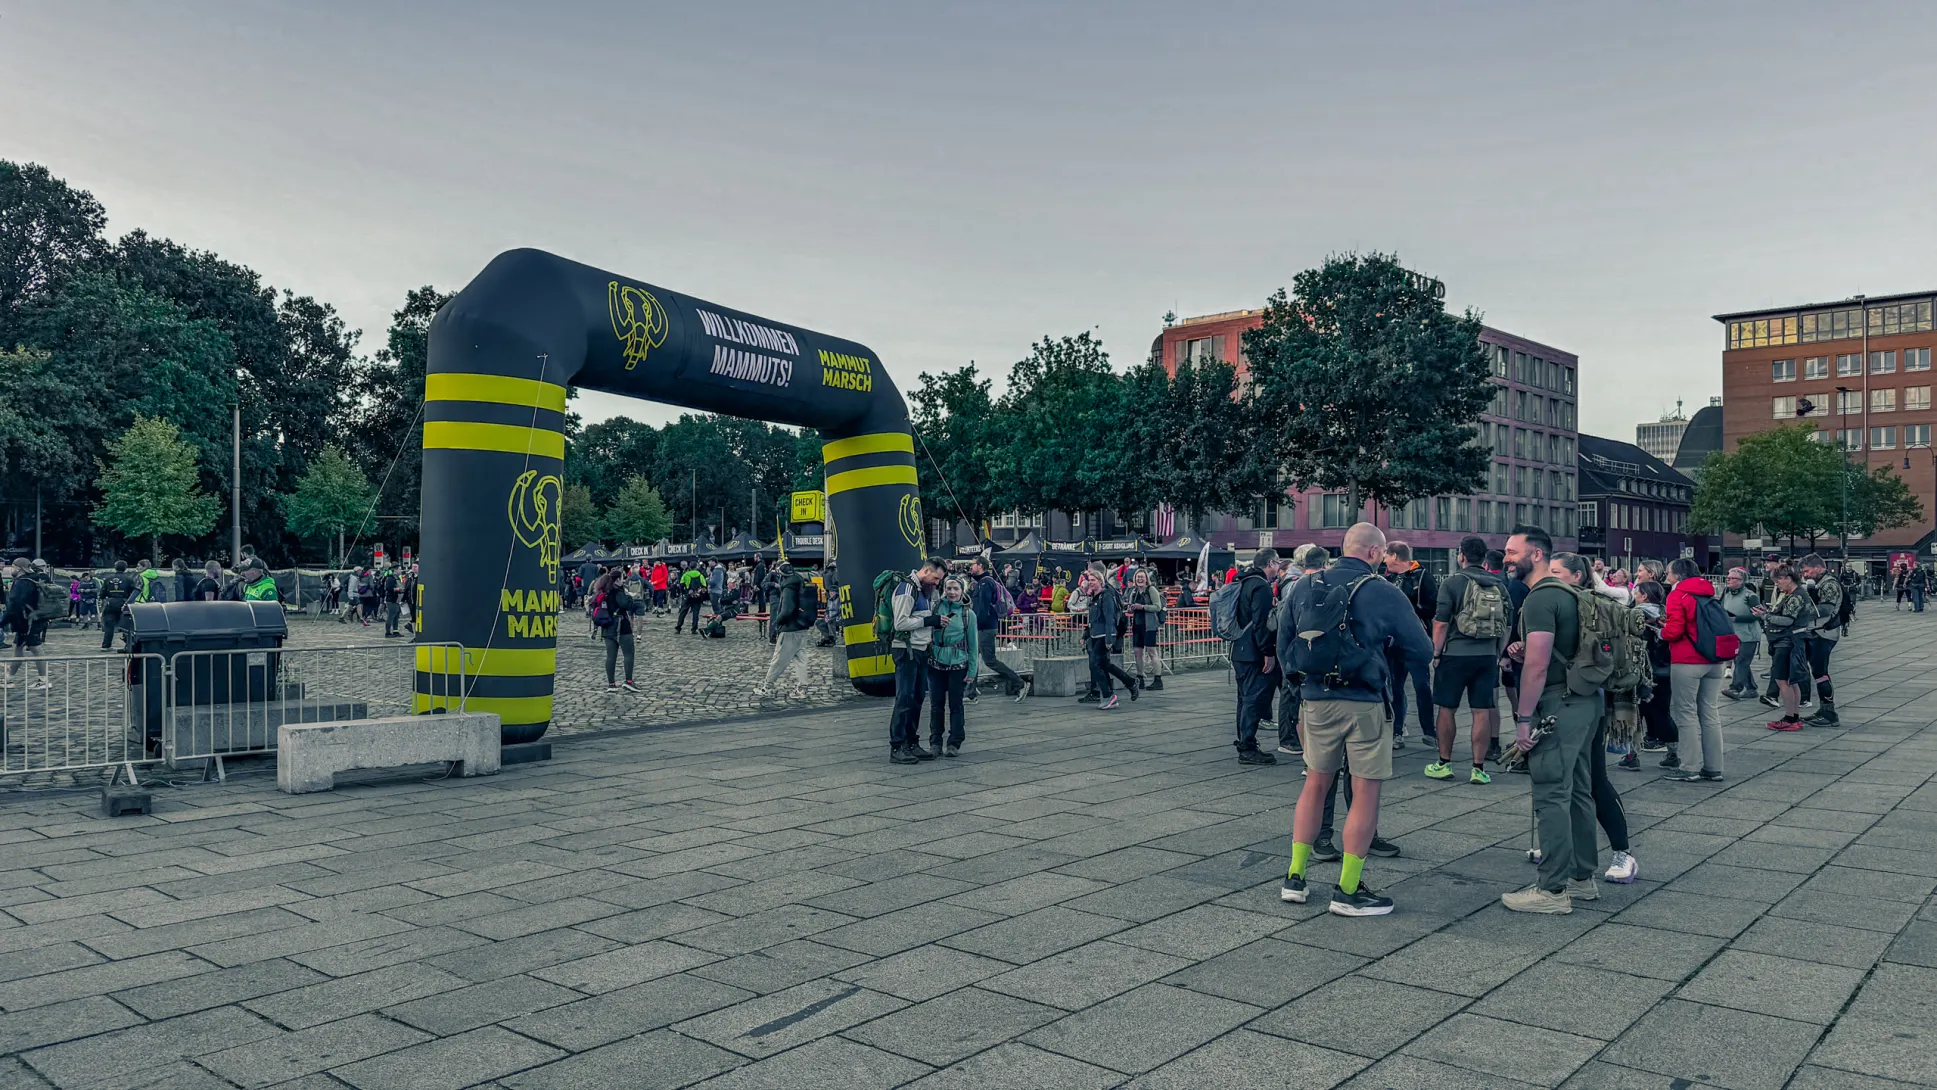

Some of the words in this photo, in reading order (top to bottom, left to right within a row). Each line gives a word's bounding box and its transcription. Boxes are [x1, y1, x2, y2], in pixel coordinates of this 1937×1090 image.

[696, 308, 800, 355] WILLKOMMEN
[709, 344, 793, 387] MAMMUTS!
[817, 349, 871, 374] MAMMUT
[822, 367, 872, 392] MARSCH
[795, 498, 813, 507] CHECK
[800, 508, 807, 516] IN
[795, 537, 812, 546] TROUBLE
[812, 537, 824, 545] DESK
[1051, 542, 1076, 550] GETRÄNKE
[630, 548, 643, 556] CHECK
[644, 546, 649, 555] IN
[668, 545, 681, 554] CHECK
[682, 544, 688, 554] IN
